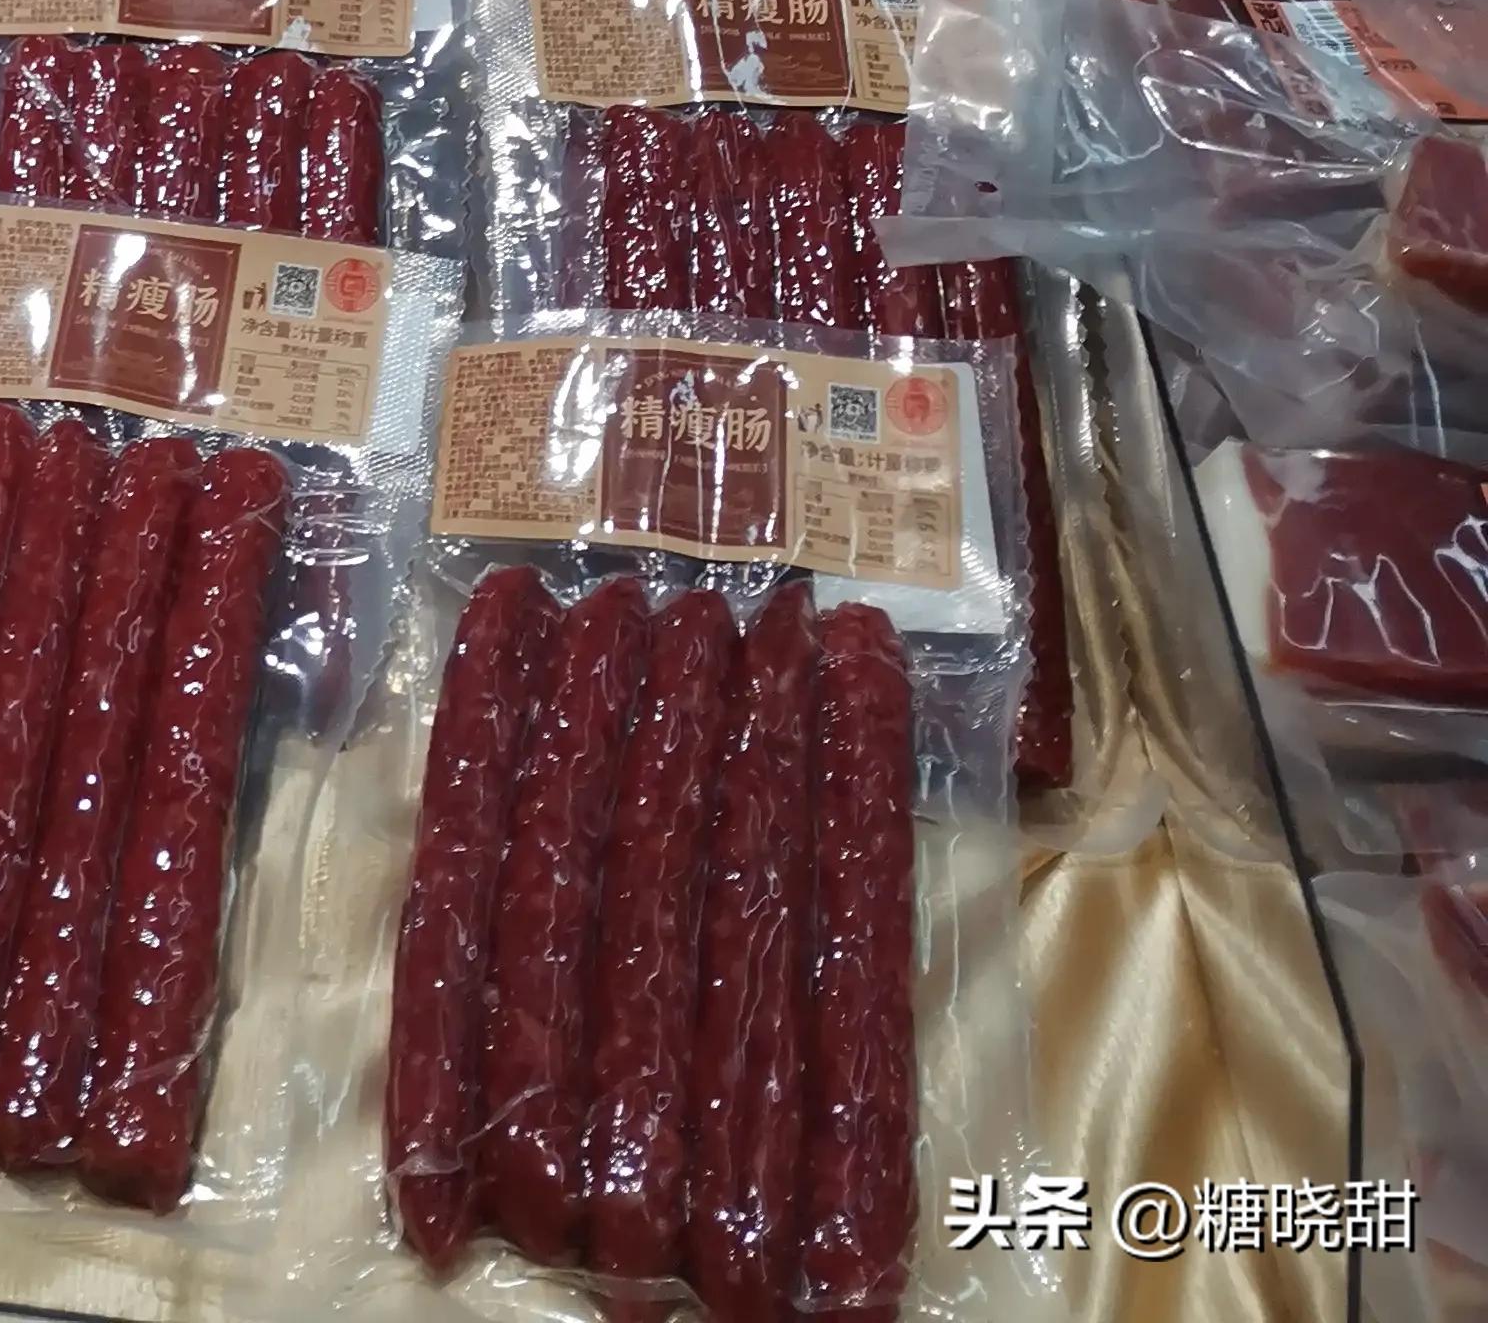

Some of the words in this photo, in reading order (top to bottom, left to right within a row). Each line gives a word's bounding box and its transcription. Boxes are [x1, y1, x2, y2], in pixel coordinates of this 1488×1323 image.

[80, 267, 221, 329] 精瘦肠
[619, 394, 773, 453] 精瘦肠
